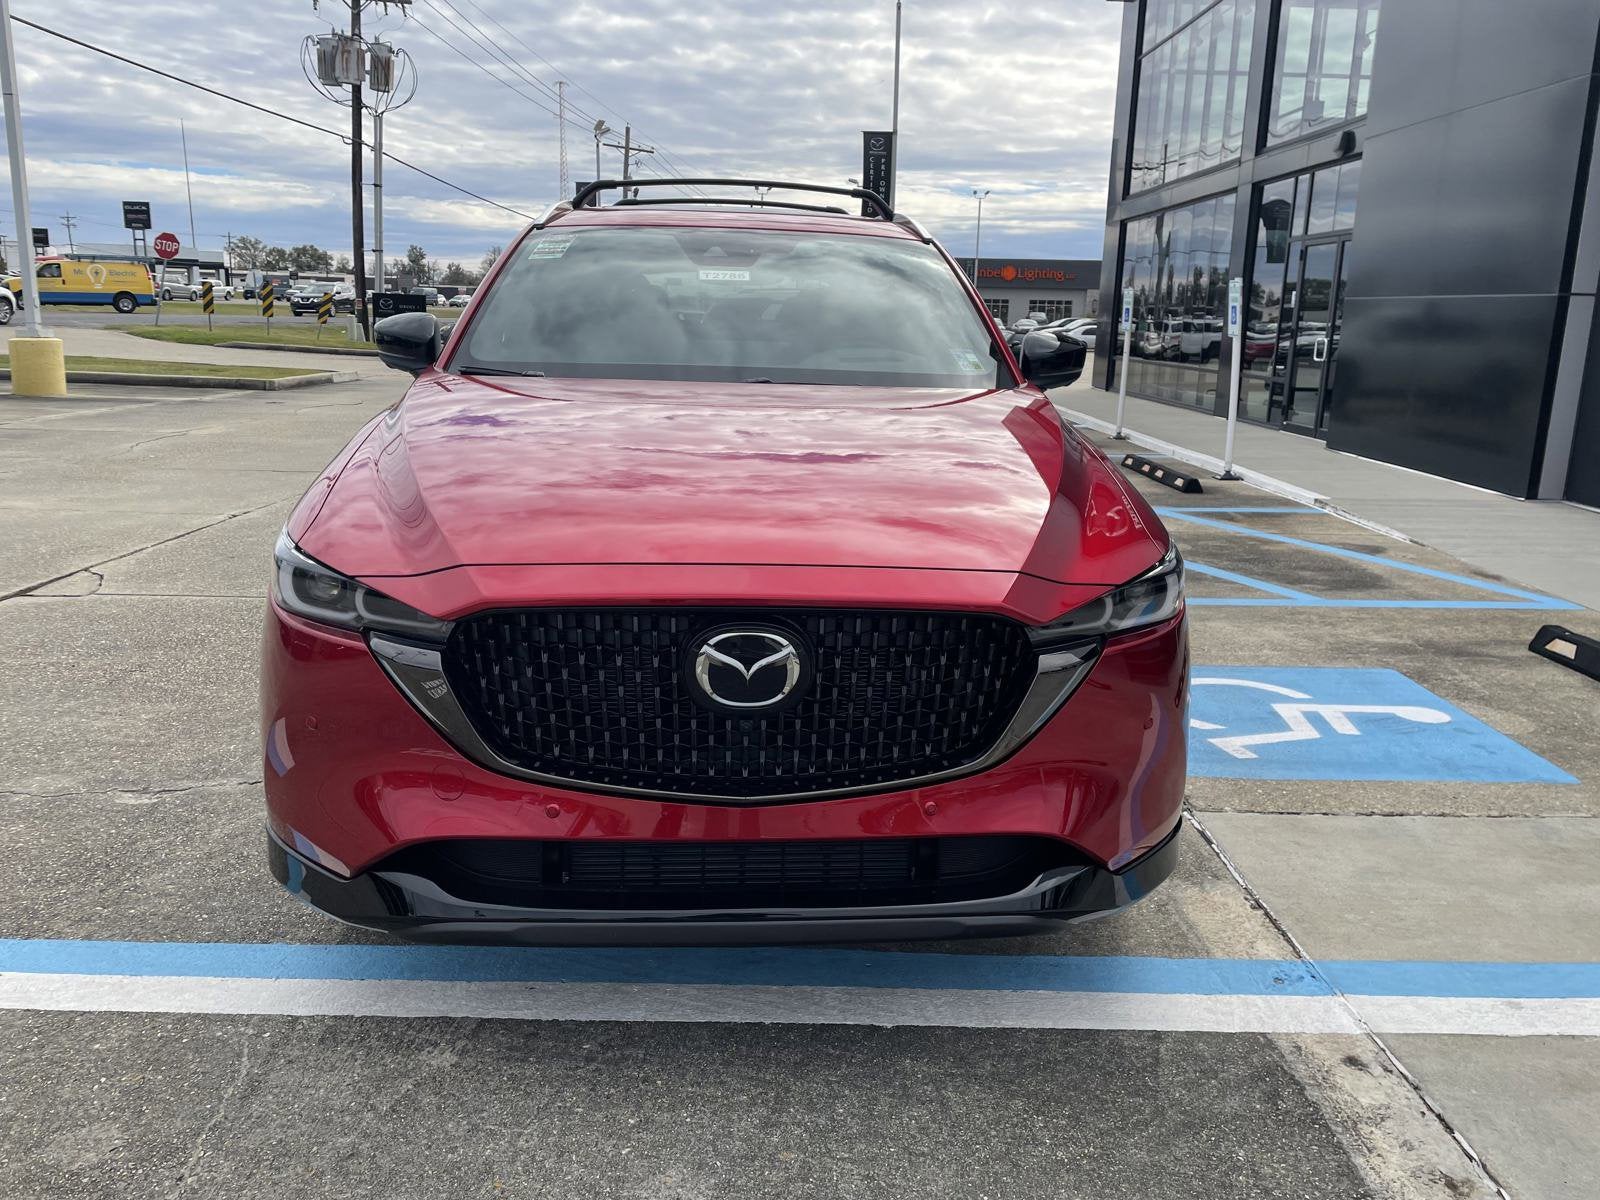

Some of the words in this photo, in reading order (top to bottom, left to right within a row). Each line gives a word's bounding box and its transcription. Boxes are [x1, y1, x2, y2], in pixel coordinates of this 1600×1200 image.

[867, 156, 875, 213] CERTIED
[154, 240, 179, 252] STOP
[1018, 267, 1064, 281] Lighting
